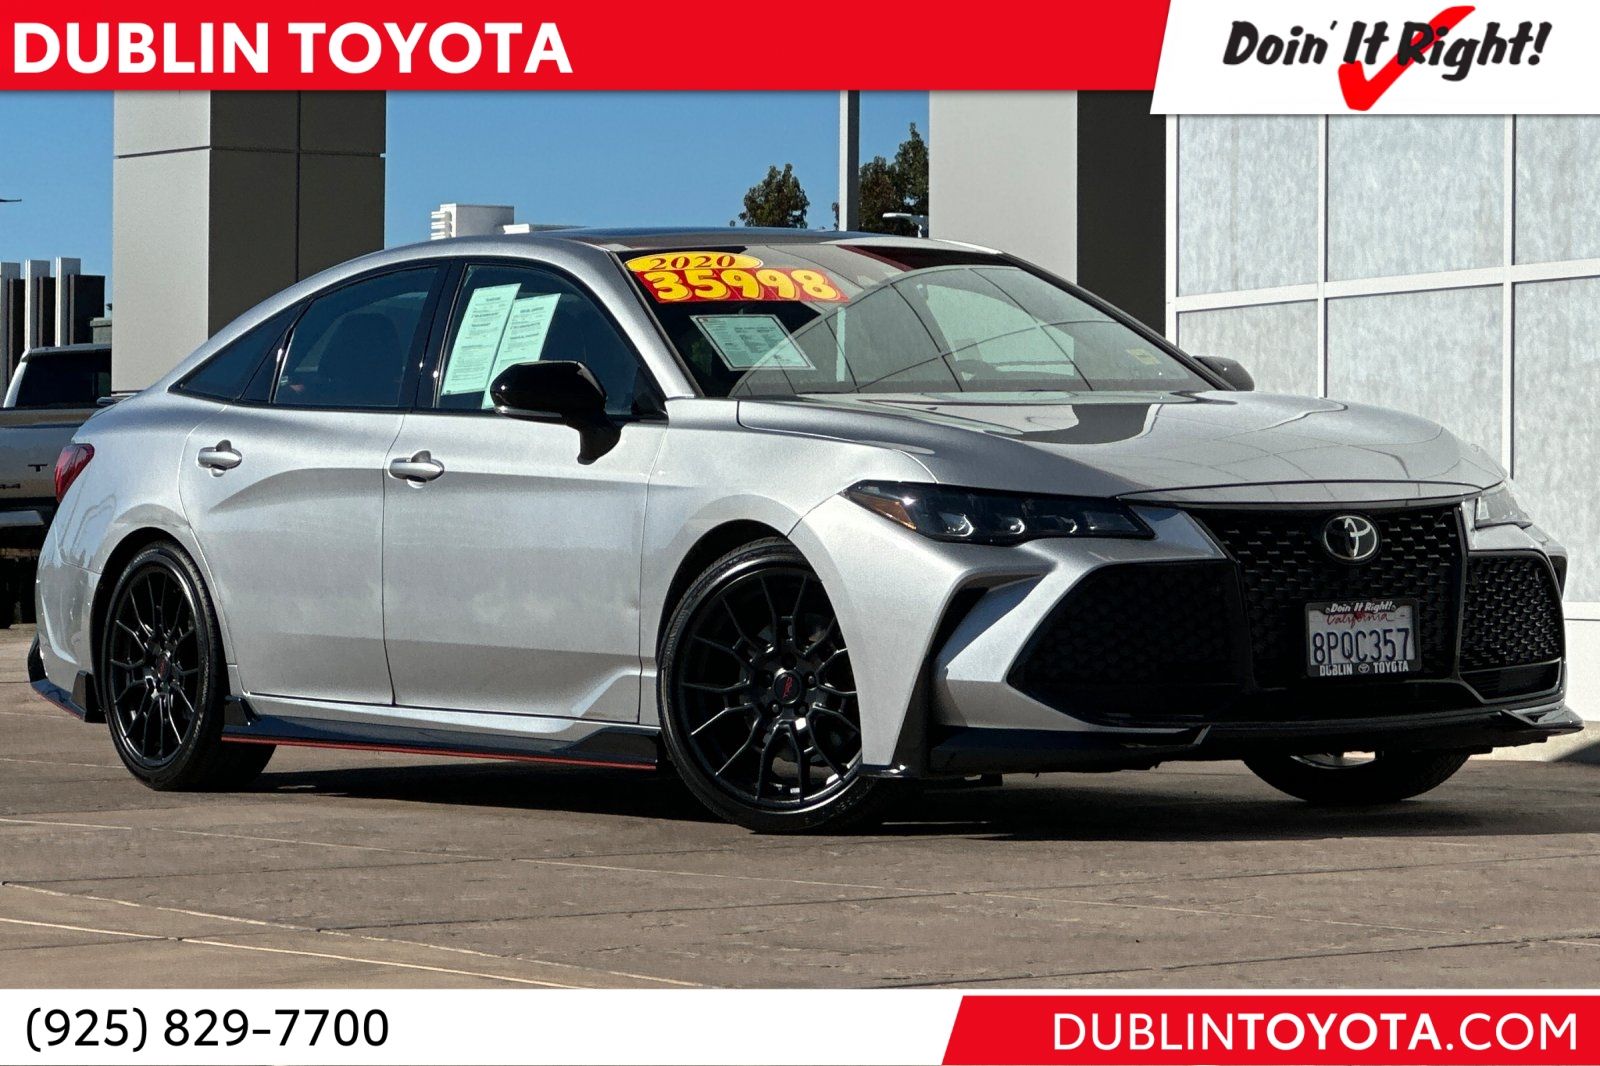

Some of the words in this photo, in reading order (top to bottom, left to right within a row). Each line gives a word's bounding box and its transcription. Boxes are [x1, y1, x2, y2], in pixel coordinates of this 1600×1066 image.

[650, 255, 736, 270] 2020
[643, 268, 843, 301] 35998
[1312, 627, 1410, 664] 8PQC357
[1319, 663, 1353, 677] DUBLIN
[1373, 659, 1409, 674] TOYOTA
